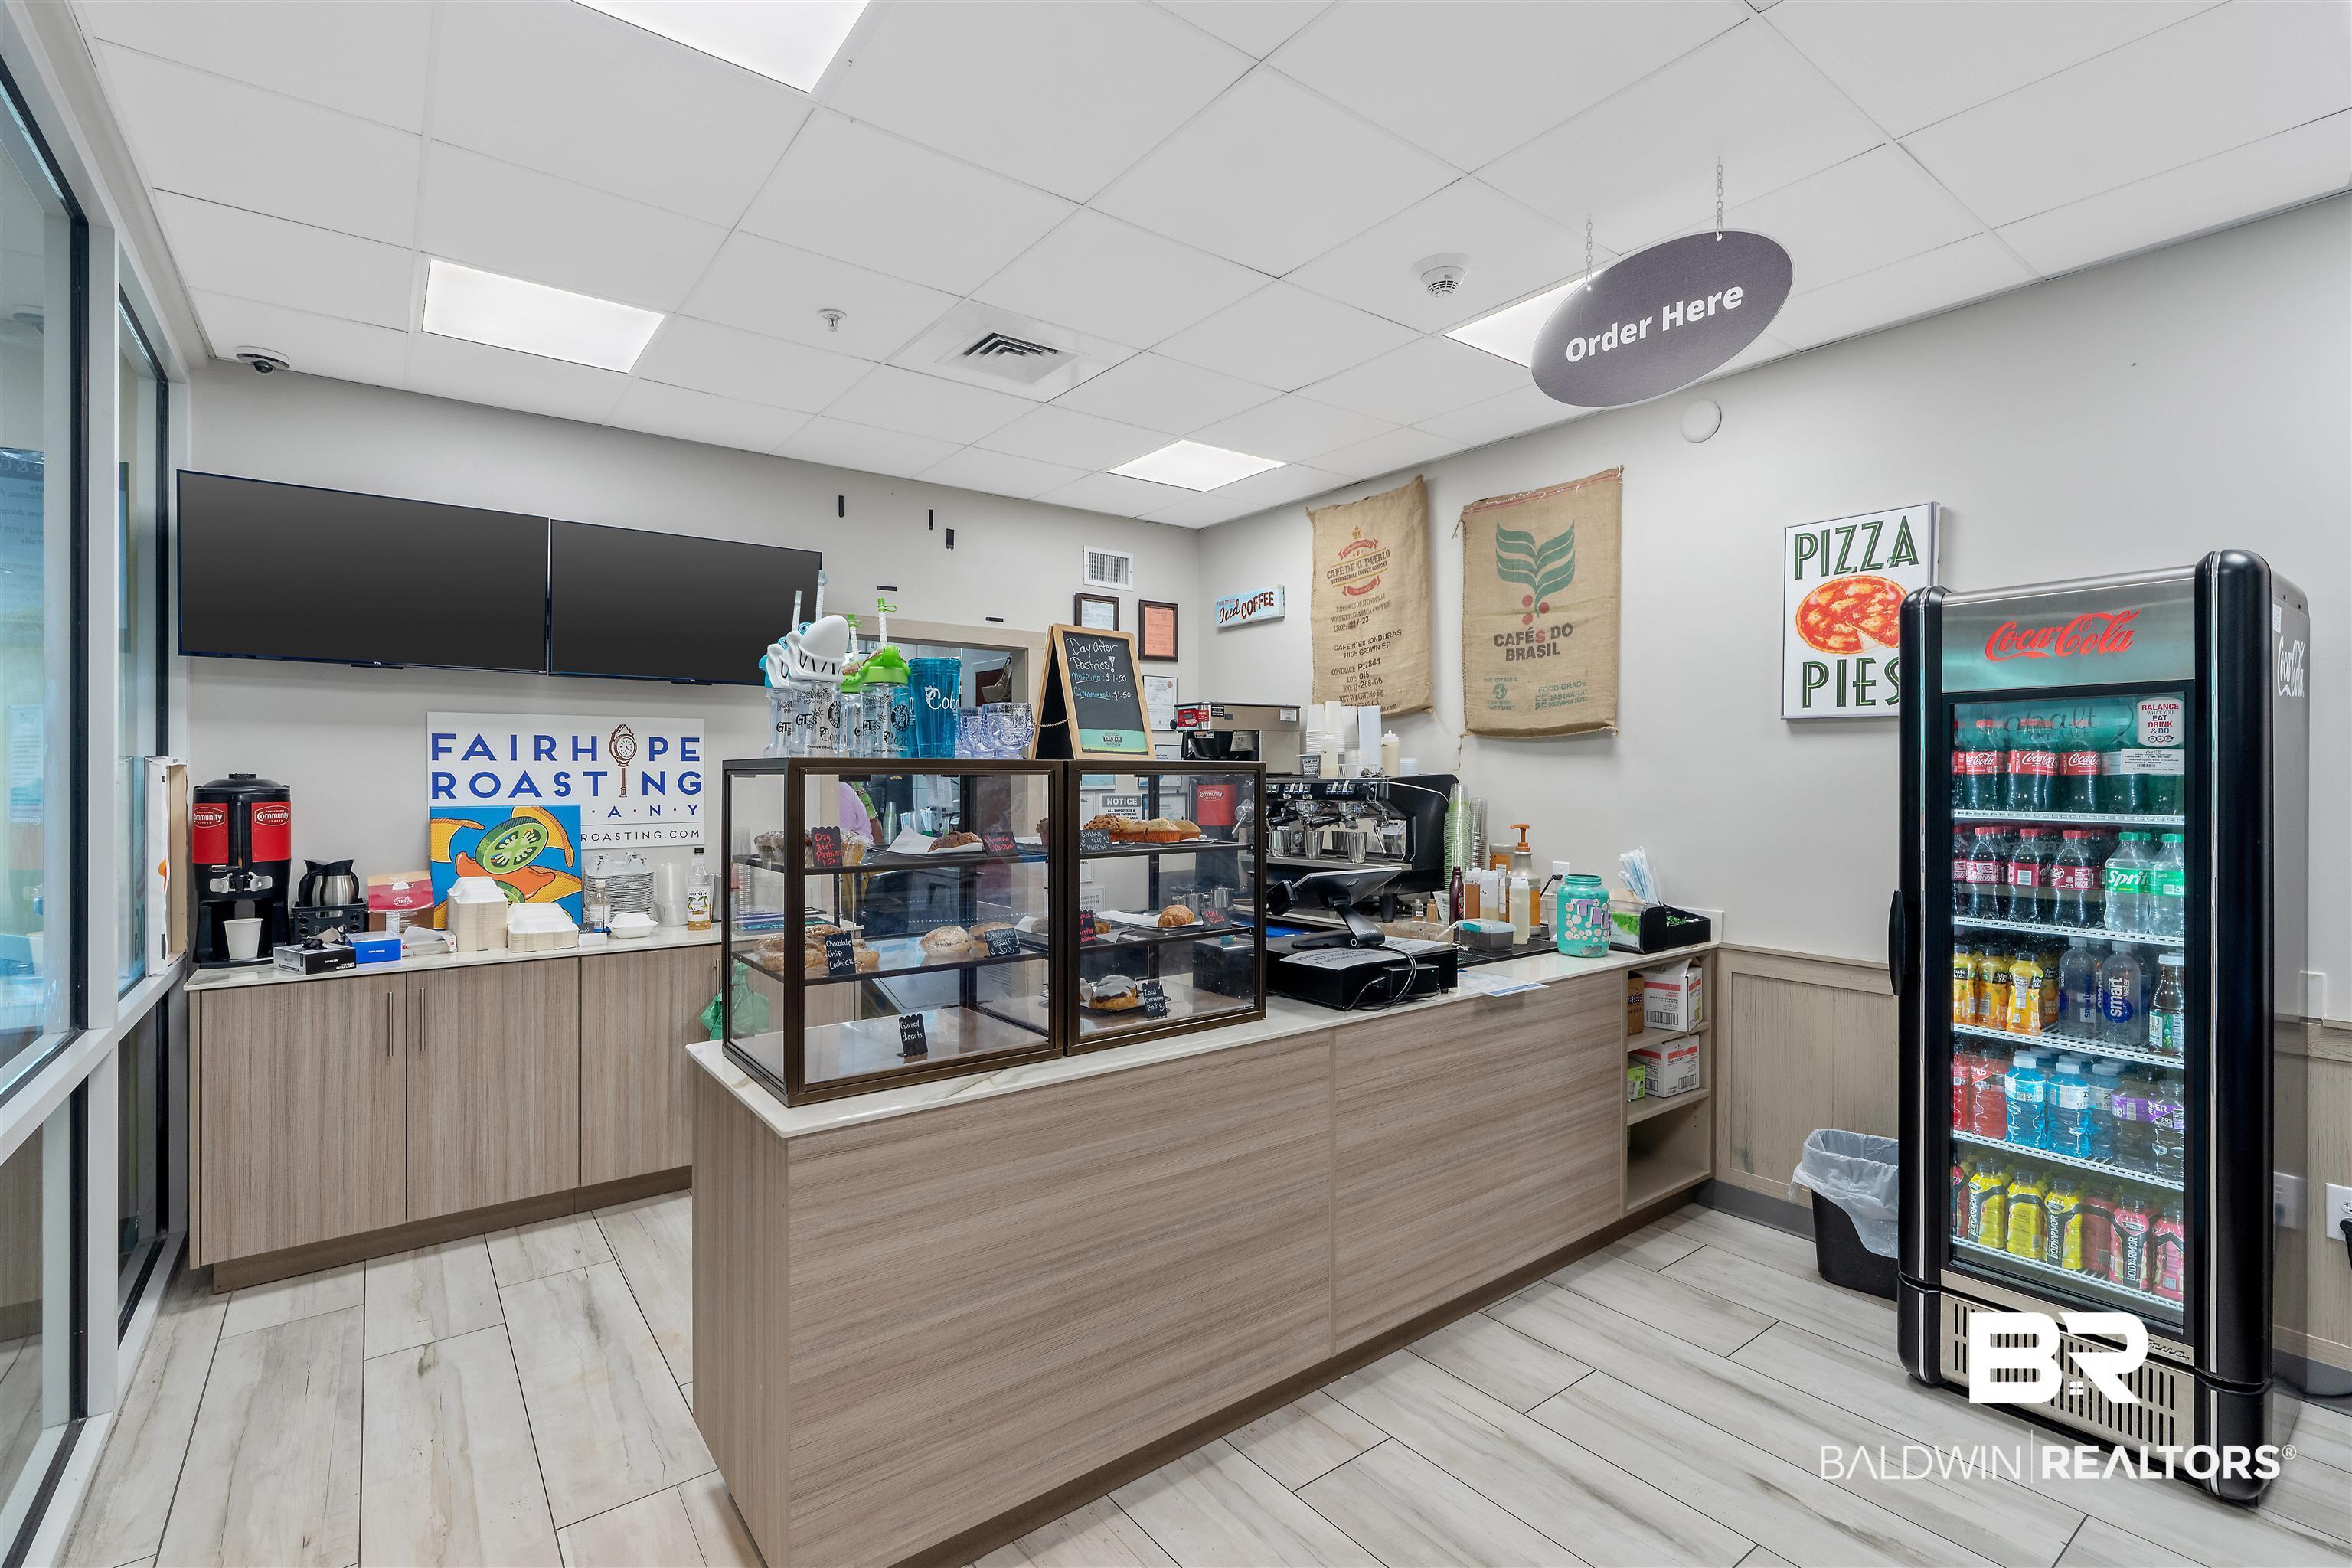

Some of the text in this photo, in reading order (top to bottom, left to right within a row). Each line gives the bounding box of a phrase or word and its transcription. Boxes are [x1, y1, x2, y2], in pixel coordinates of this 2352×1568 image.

[1566, 286, 1743, 363] Order Here
[1794, 515, 1919, 580] PIZZA
[1344, 563, 1355, 573] DE
[1364, 549, 1390, 567] PUEBLO
[1220, 591, 1274, 623] Iced COFFEE
[1330, 613, 1352, 622] WASHED
[1372, 600, 1391, 612] COFFEE
[1493, 622, 1574, 648] CAFÉS DO
[1984, 609, 2141, 662] Coca-Cola
[1066, 637, 1091, 658] Day
[1344, 650, 1358, 658] HIGH
[1359, 644, 1380, 655] GROWN
[1505, 642, 1561, 662] BRASIL
[1357, 657, 1381, 671] P22841
[1538, 680, 1587, 694] FOOD GRADE
[1802, 657, 1900, 708] PIES
[581, 829, 700, 842] ROASTING.COM
[2107, 870, 2150, 887] Sprit
[825, 939, 851, 947] Chocolate
[829, 959, 854, 969] Cookies
[2109, 976, 2122, 1018] smart
[2122, 978, 2131, 997] water
[2050, 1214, 2059, 1259] BODYARMOR
[2127, 1236, 2138, 1281] BODYARMOR
